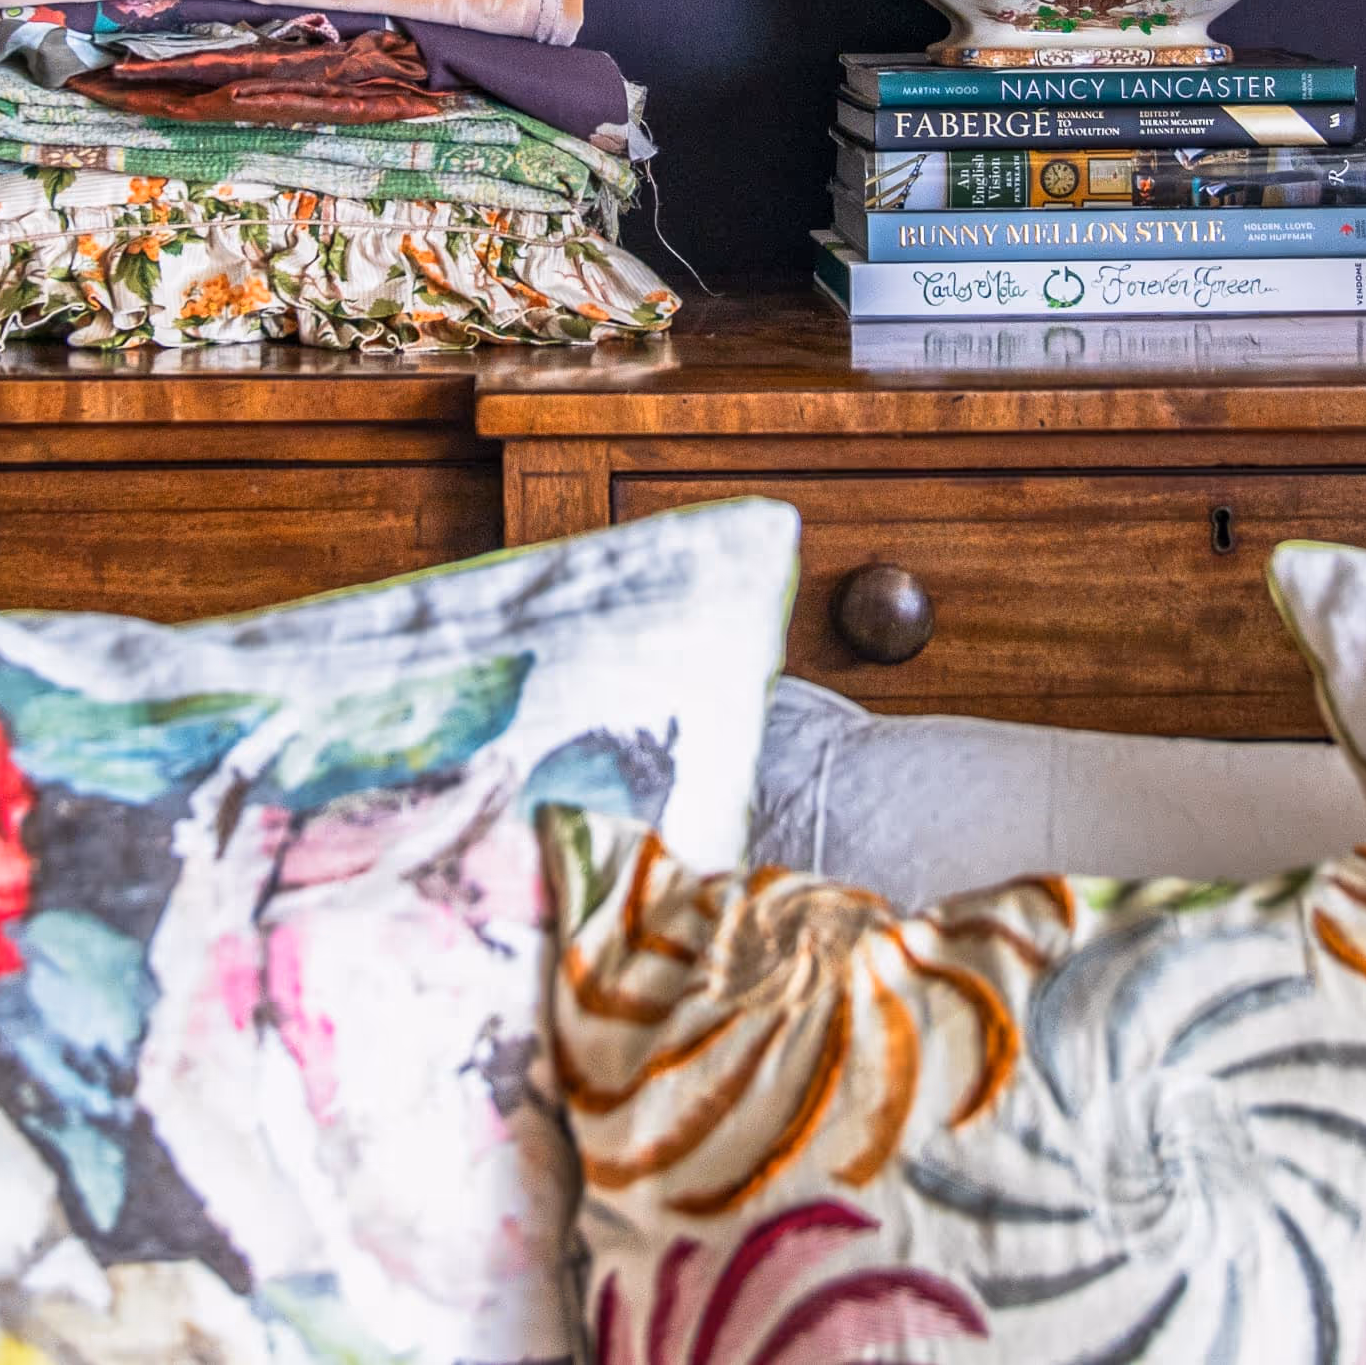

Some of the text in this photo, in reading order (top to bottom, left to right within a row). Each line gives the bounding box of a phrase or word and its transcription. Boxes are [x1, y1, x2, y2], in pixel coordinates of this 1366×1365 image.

[902, 76, 1276, 100] MARTIN WOOD NANCY LANCASTER
[893, 108, 1051, 138] FABERGÉ
[1057, 111, 1104, 119] ROMANCE
[1057, 119, 1071, 128] TO
[1139, 110, 1180, 118] EDITED BY
[1057, 127, 1120, 136] REVOLUTION
[1146, 127, 1174, 135] HANNE
[957, 169, 970, 190] An
[971, 154, 988, 204] English
[988, 157, 1001, 200] Vision
[899, 220, 1226, 248] BUNNY MELLON STYLE
[1248, 233, 1313, 242] AND HUFFMAN
[913, 270, 1028, 307] Carlos Mota
[1093, 264, 1275, 308] Forever Green
[1354, 262, 1363, 306] VENDOME
